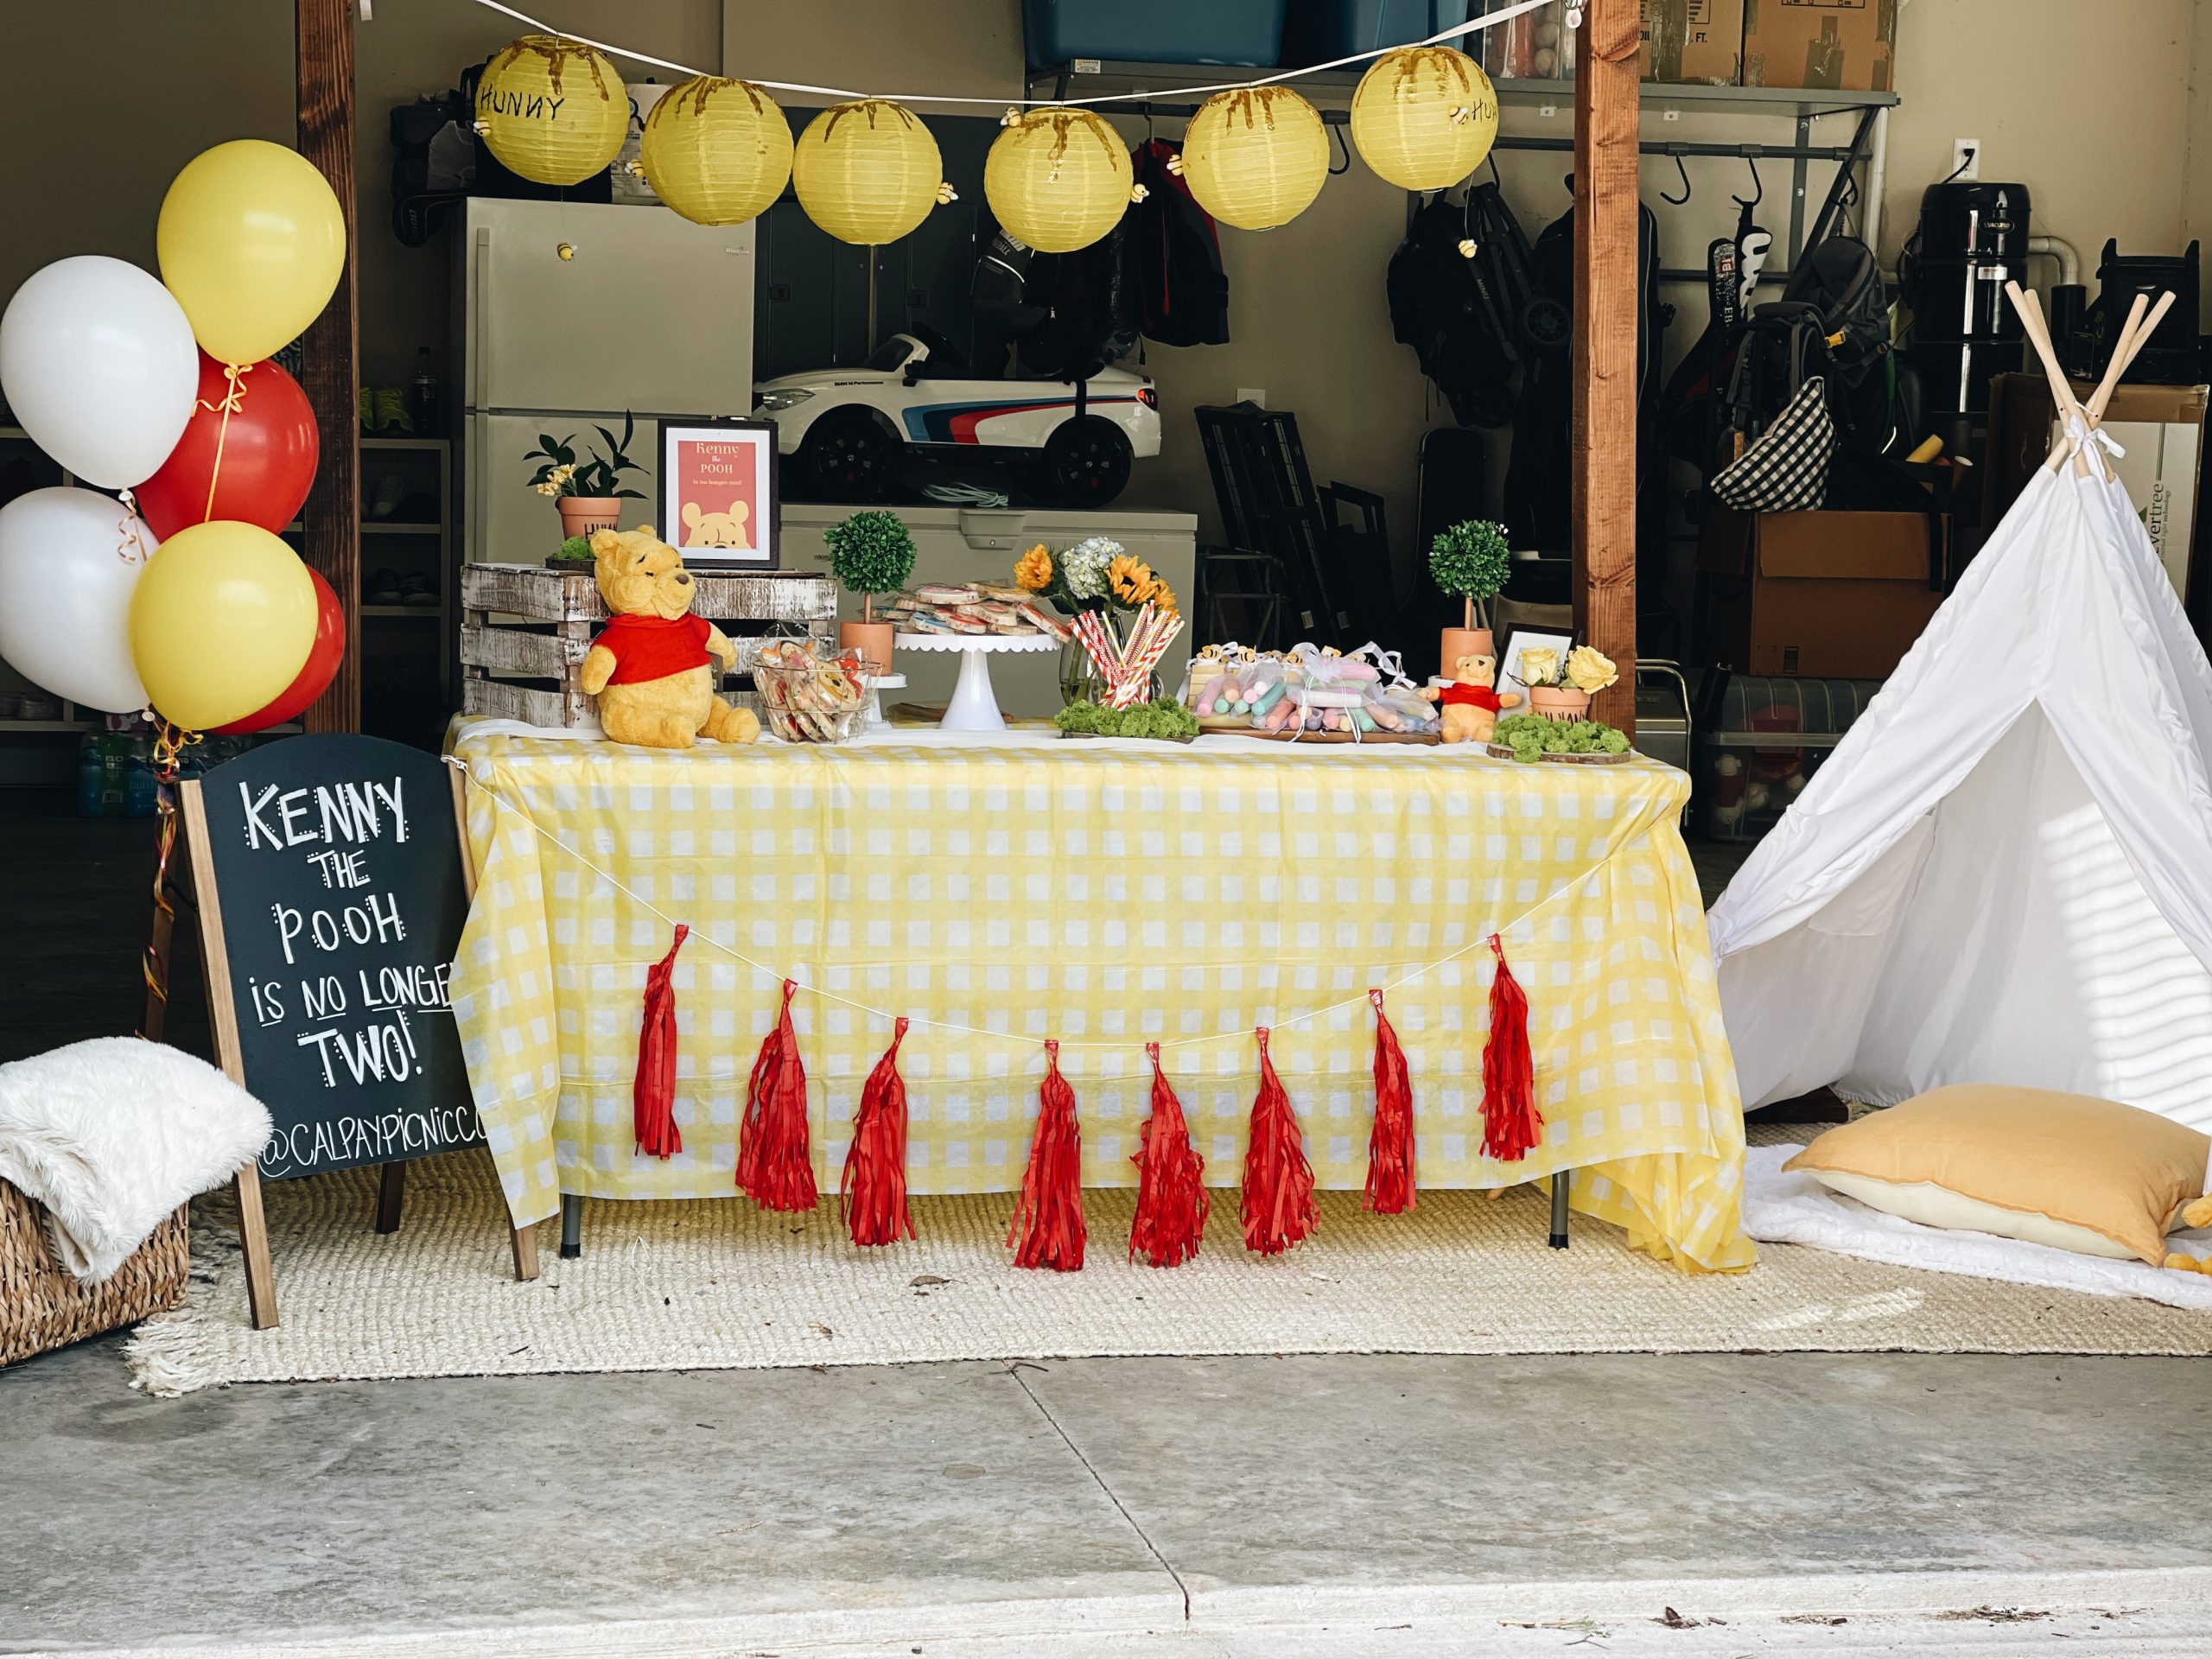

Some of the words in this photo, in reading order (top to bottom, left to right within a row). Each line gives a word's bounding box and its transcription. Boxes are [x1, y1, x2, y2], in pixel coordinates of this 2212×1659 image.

[696, 442, 739, 458] Kenny
[701, 464, 733, 474] POOH
[239, 776, 410, 851] KENNY
[307, 849, 371, 888] THE
[270, 893, 406, 964] POOH
[302, 976, 346, 1019] NO
[359, 962, 453, 1007] LONGE
[297, 1010, 423, 1088] TWO!
